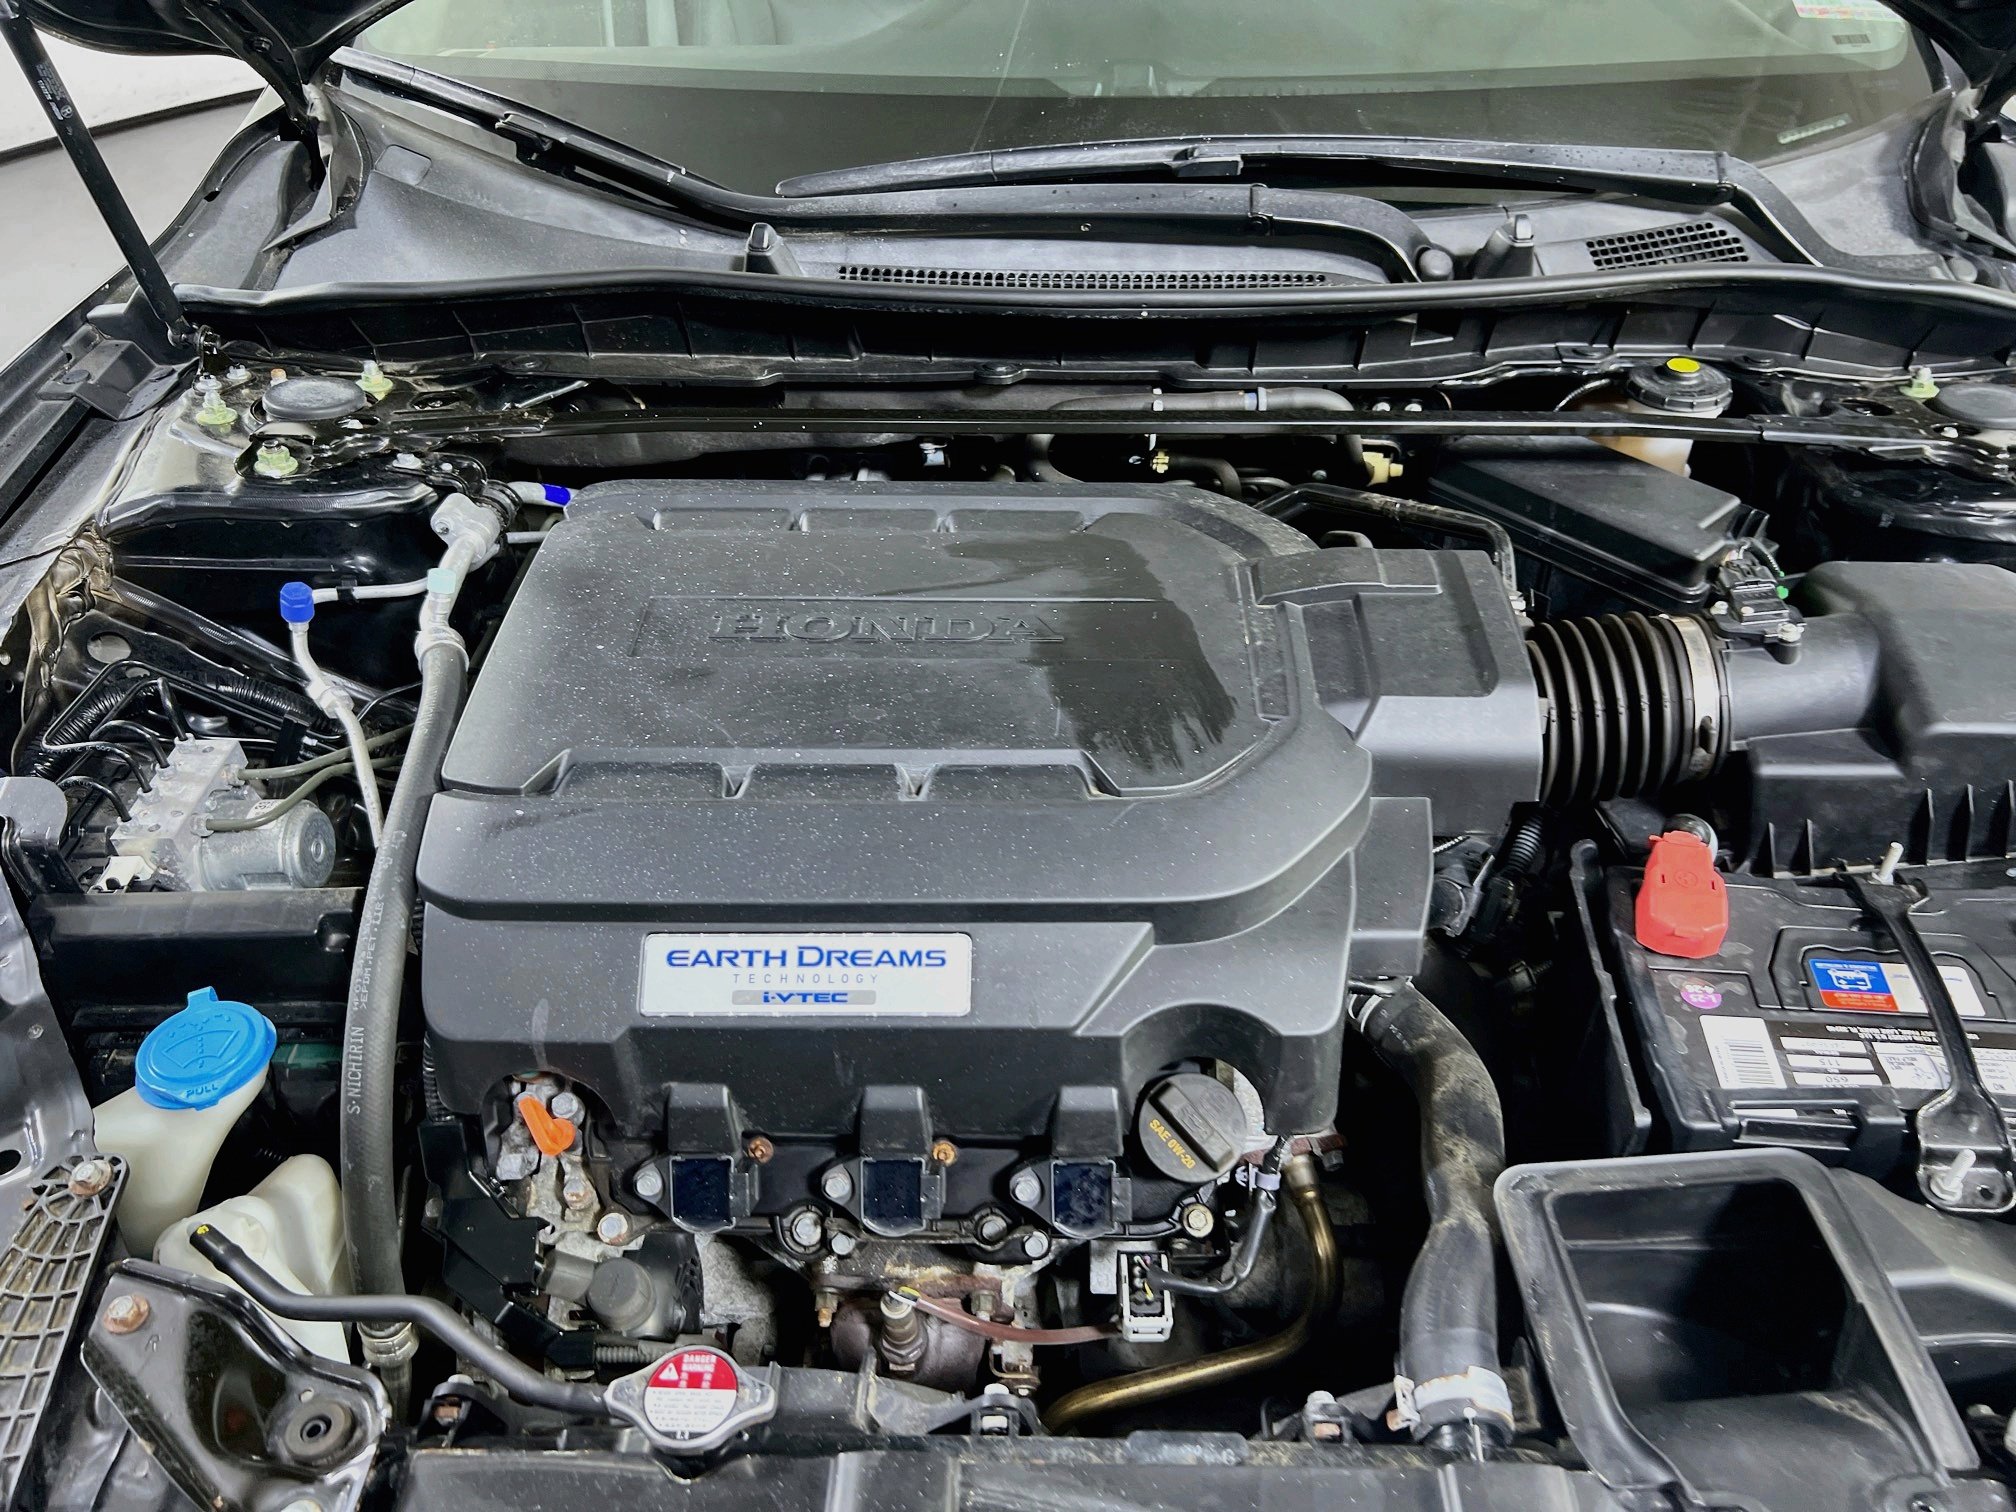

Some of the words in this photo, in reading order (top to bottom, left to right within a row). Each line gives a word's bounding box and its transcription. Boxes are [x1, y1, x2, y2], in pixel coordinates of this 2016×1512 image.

[708, 612, 1065, 643] HONDA
[666, 948, 788, 967] EARTH
[797, 945, 947, 967] DREAMS
[732, 973, 880, 984] TECHNOLOGY
[1818, 1058, 1840, 1067] 115
[185, 1083, 219, 1098] PULL
[1149, 1118, 1169, 1143] SAE
[1167, 1138, 1198, 1170] 0W-20
